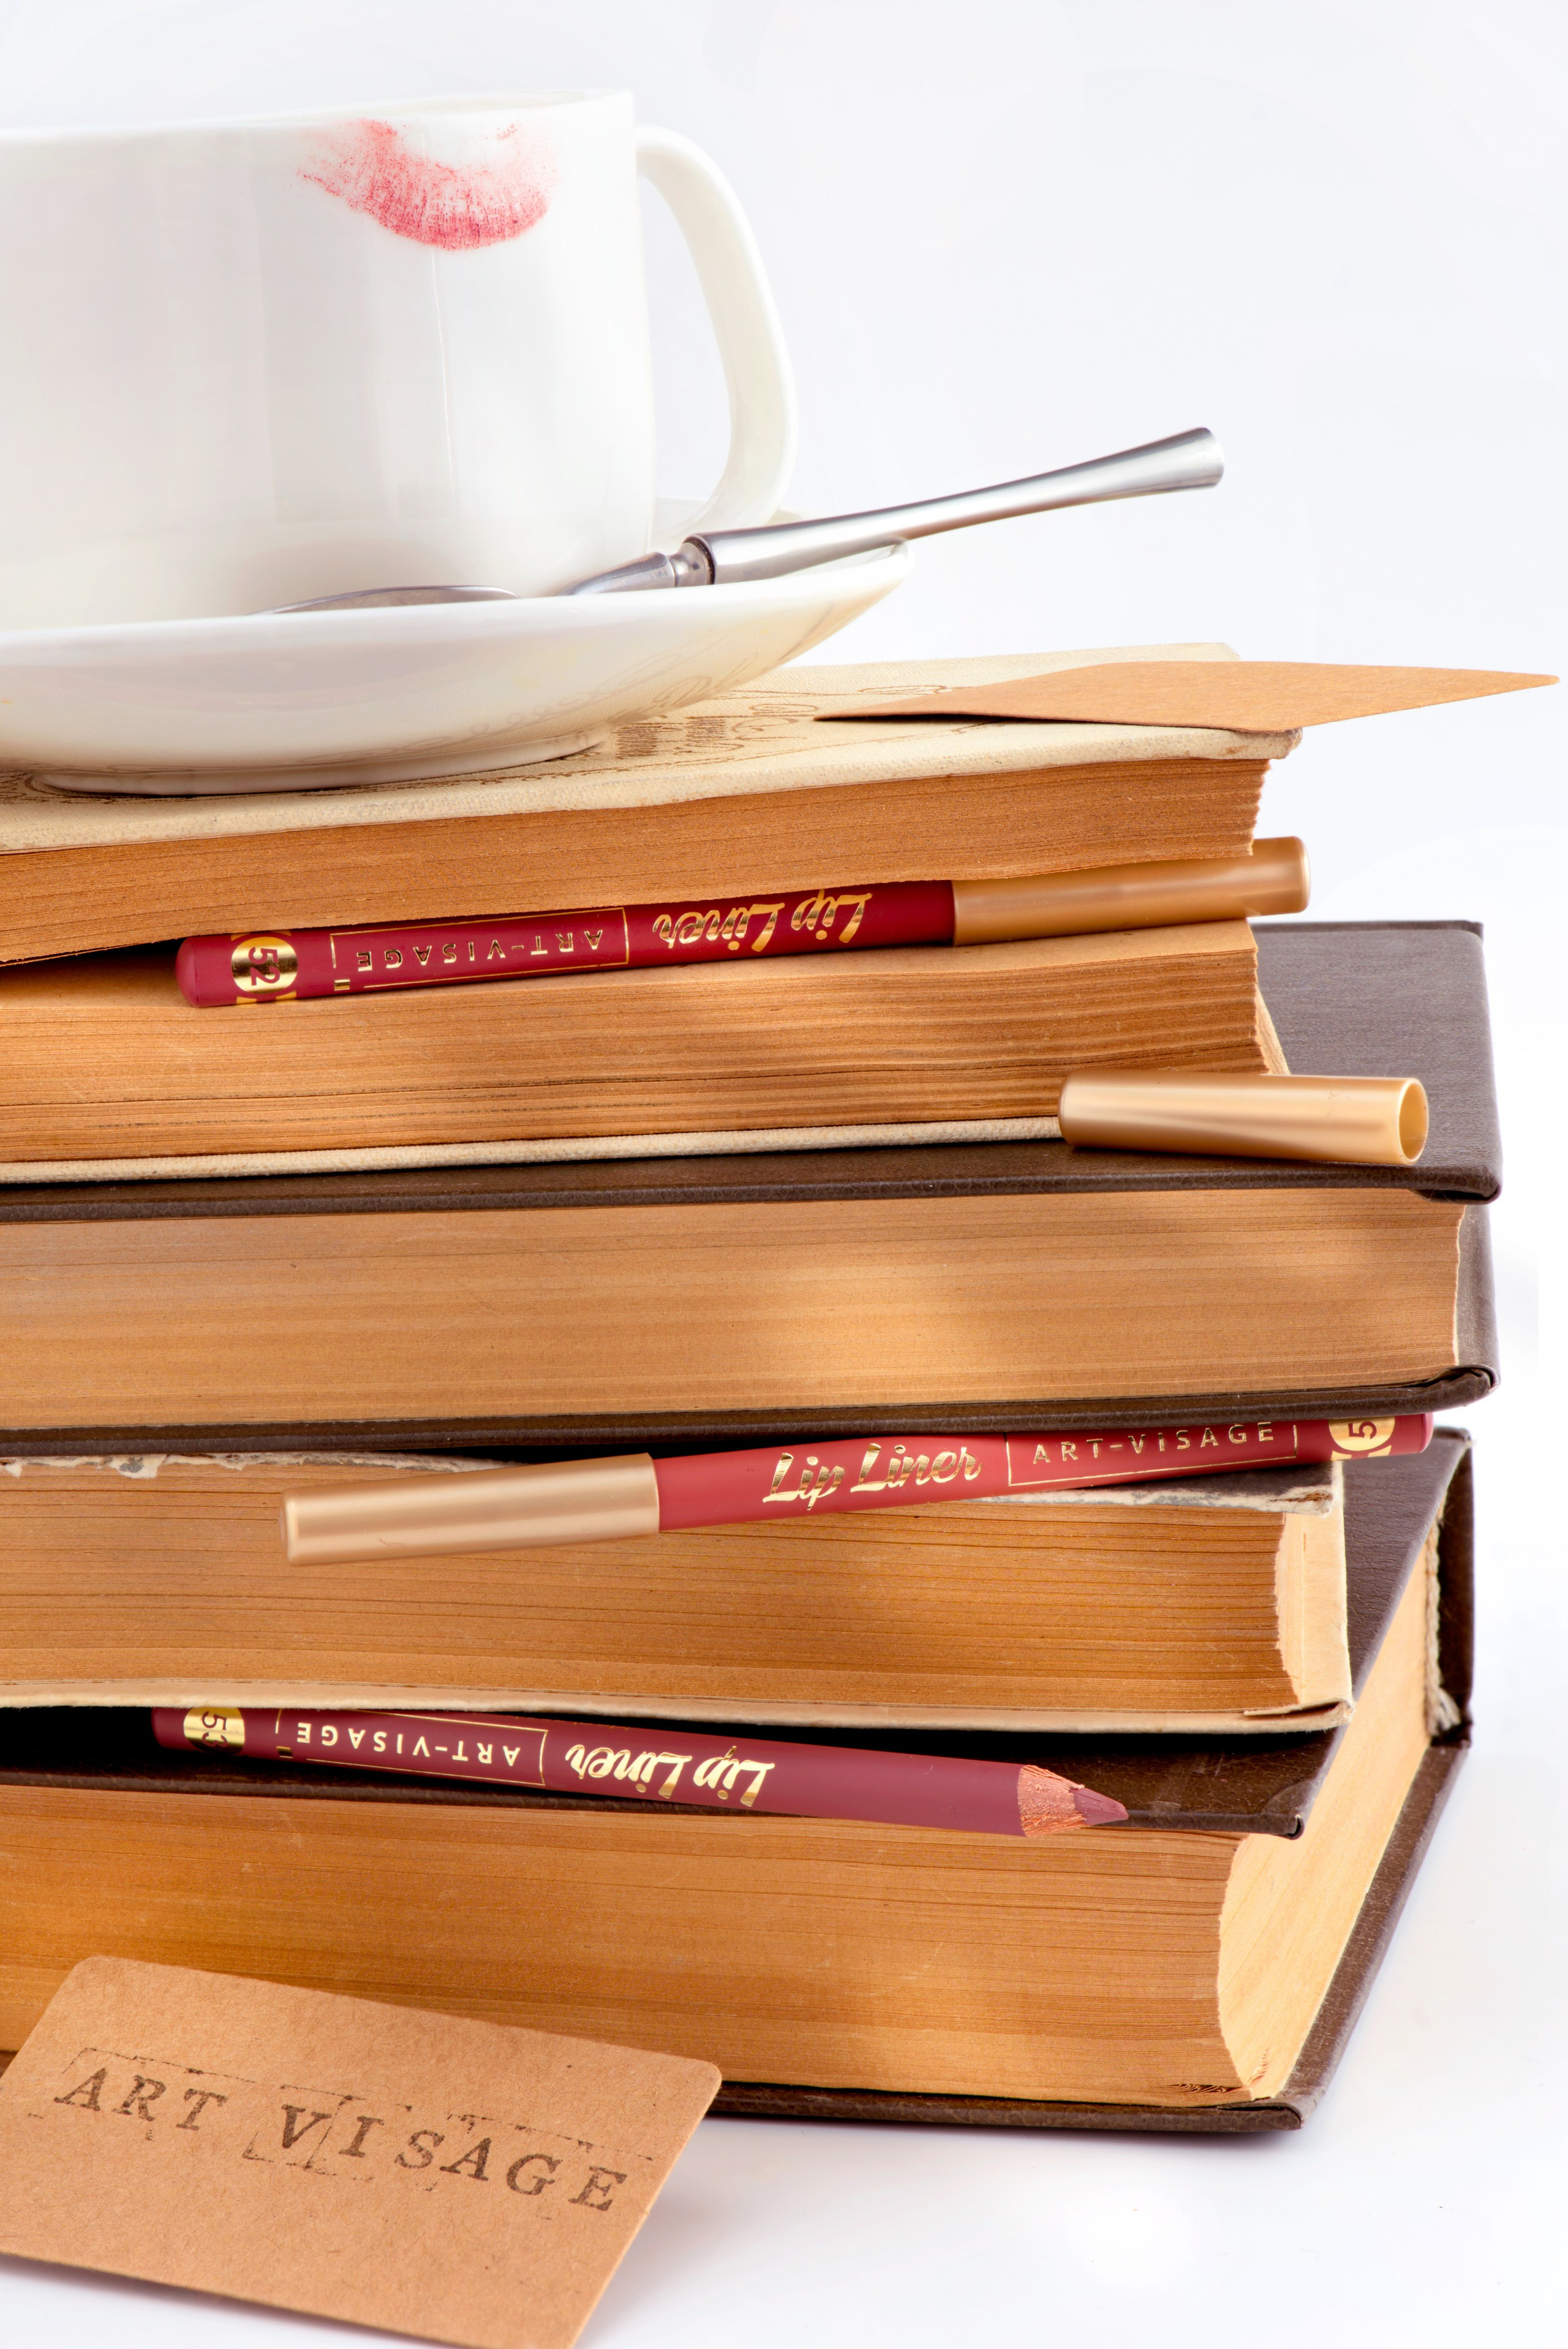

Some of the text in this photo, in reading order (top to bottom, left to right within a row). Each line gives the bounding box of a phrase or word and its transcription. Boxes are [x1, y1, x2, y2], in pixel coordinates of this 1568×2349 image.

[652, 888, 873, 952] Lip Liner
[247, 946, 281, 986] 52
[356, 929, 604, 971] ART-VISAGE
[1033, 1422, 1274, 1465] ART-VISAGE
[763, 1442, 982, 1510] Lip Liner
[202, 1709, 228, 1749] 53
[296, 1722, 521, 1766] ART-VISAGE
[565, 1744, 775, 1807] Lip Liner
[54, 2067, 627, 2212] ART VISAGE
